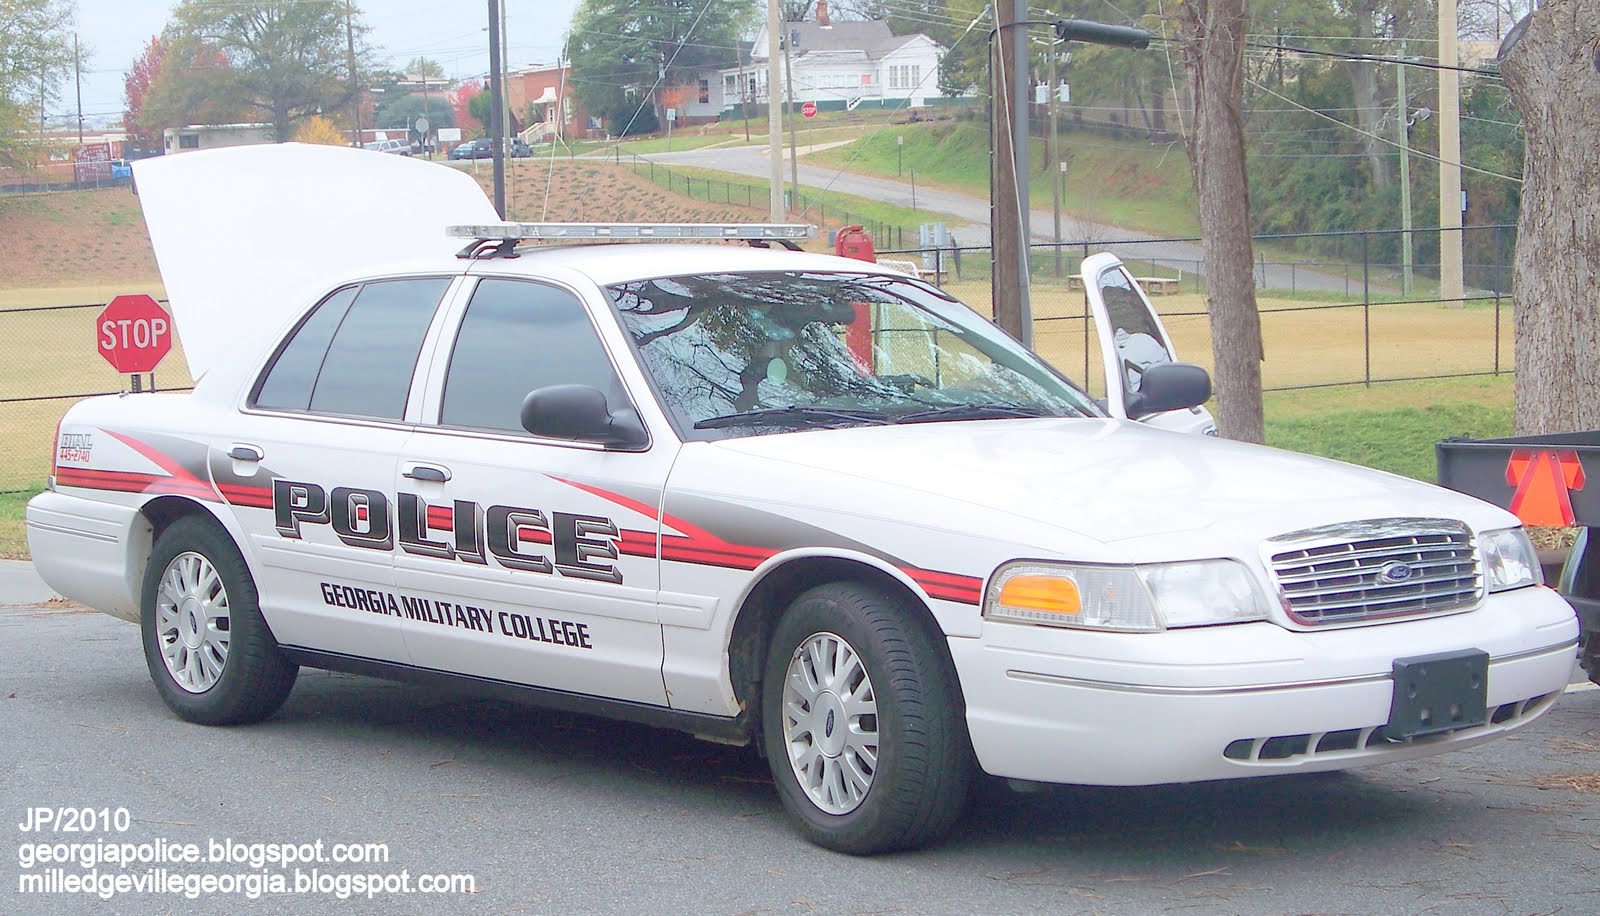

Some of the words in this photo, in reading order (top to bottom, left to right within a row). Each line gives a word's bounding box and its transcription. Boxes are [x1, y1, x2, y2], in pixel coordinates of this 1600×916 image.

[101, 318, 167, 350] STOP
[61, 433, 92, 449] DIAL
[273, 479, 624, 585] POLICE
[320, 582, 401, 617] GEORGIA
[400, 595, 494, 633] MILITARY
[498, 611, 593, 649] COLLEGE
